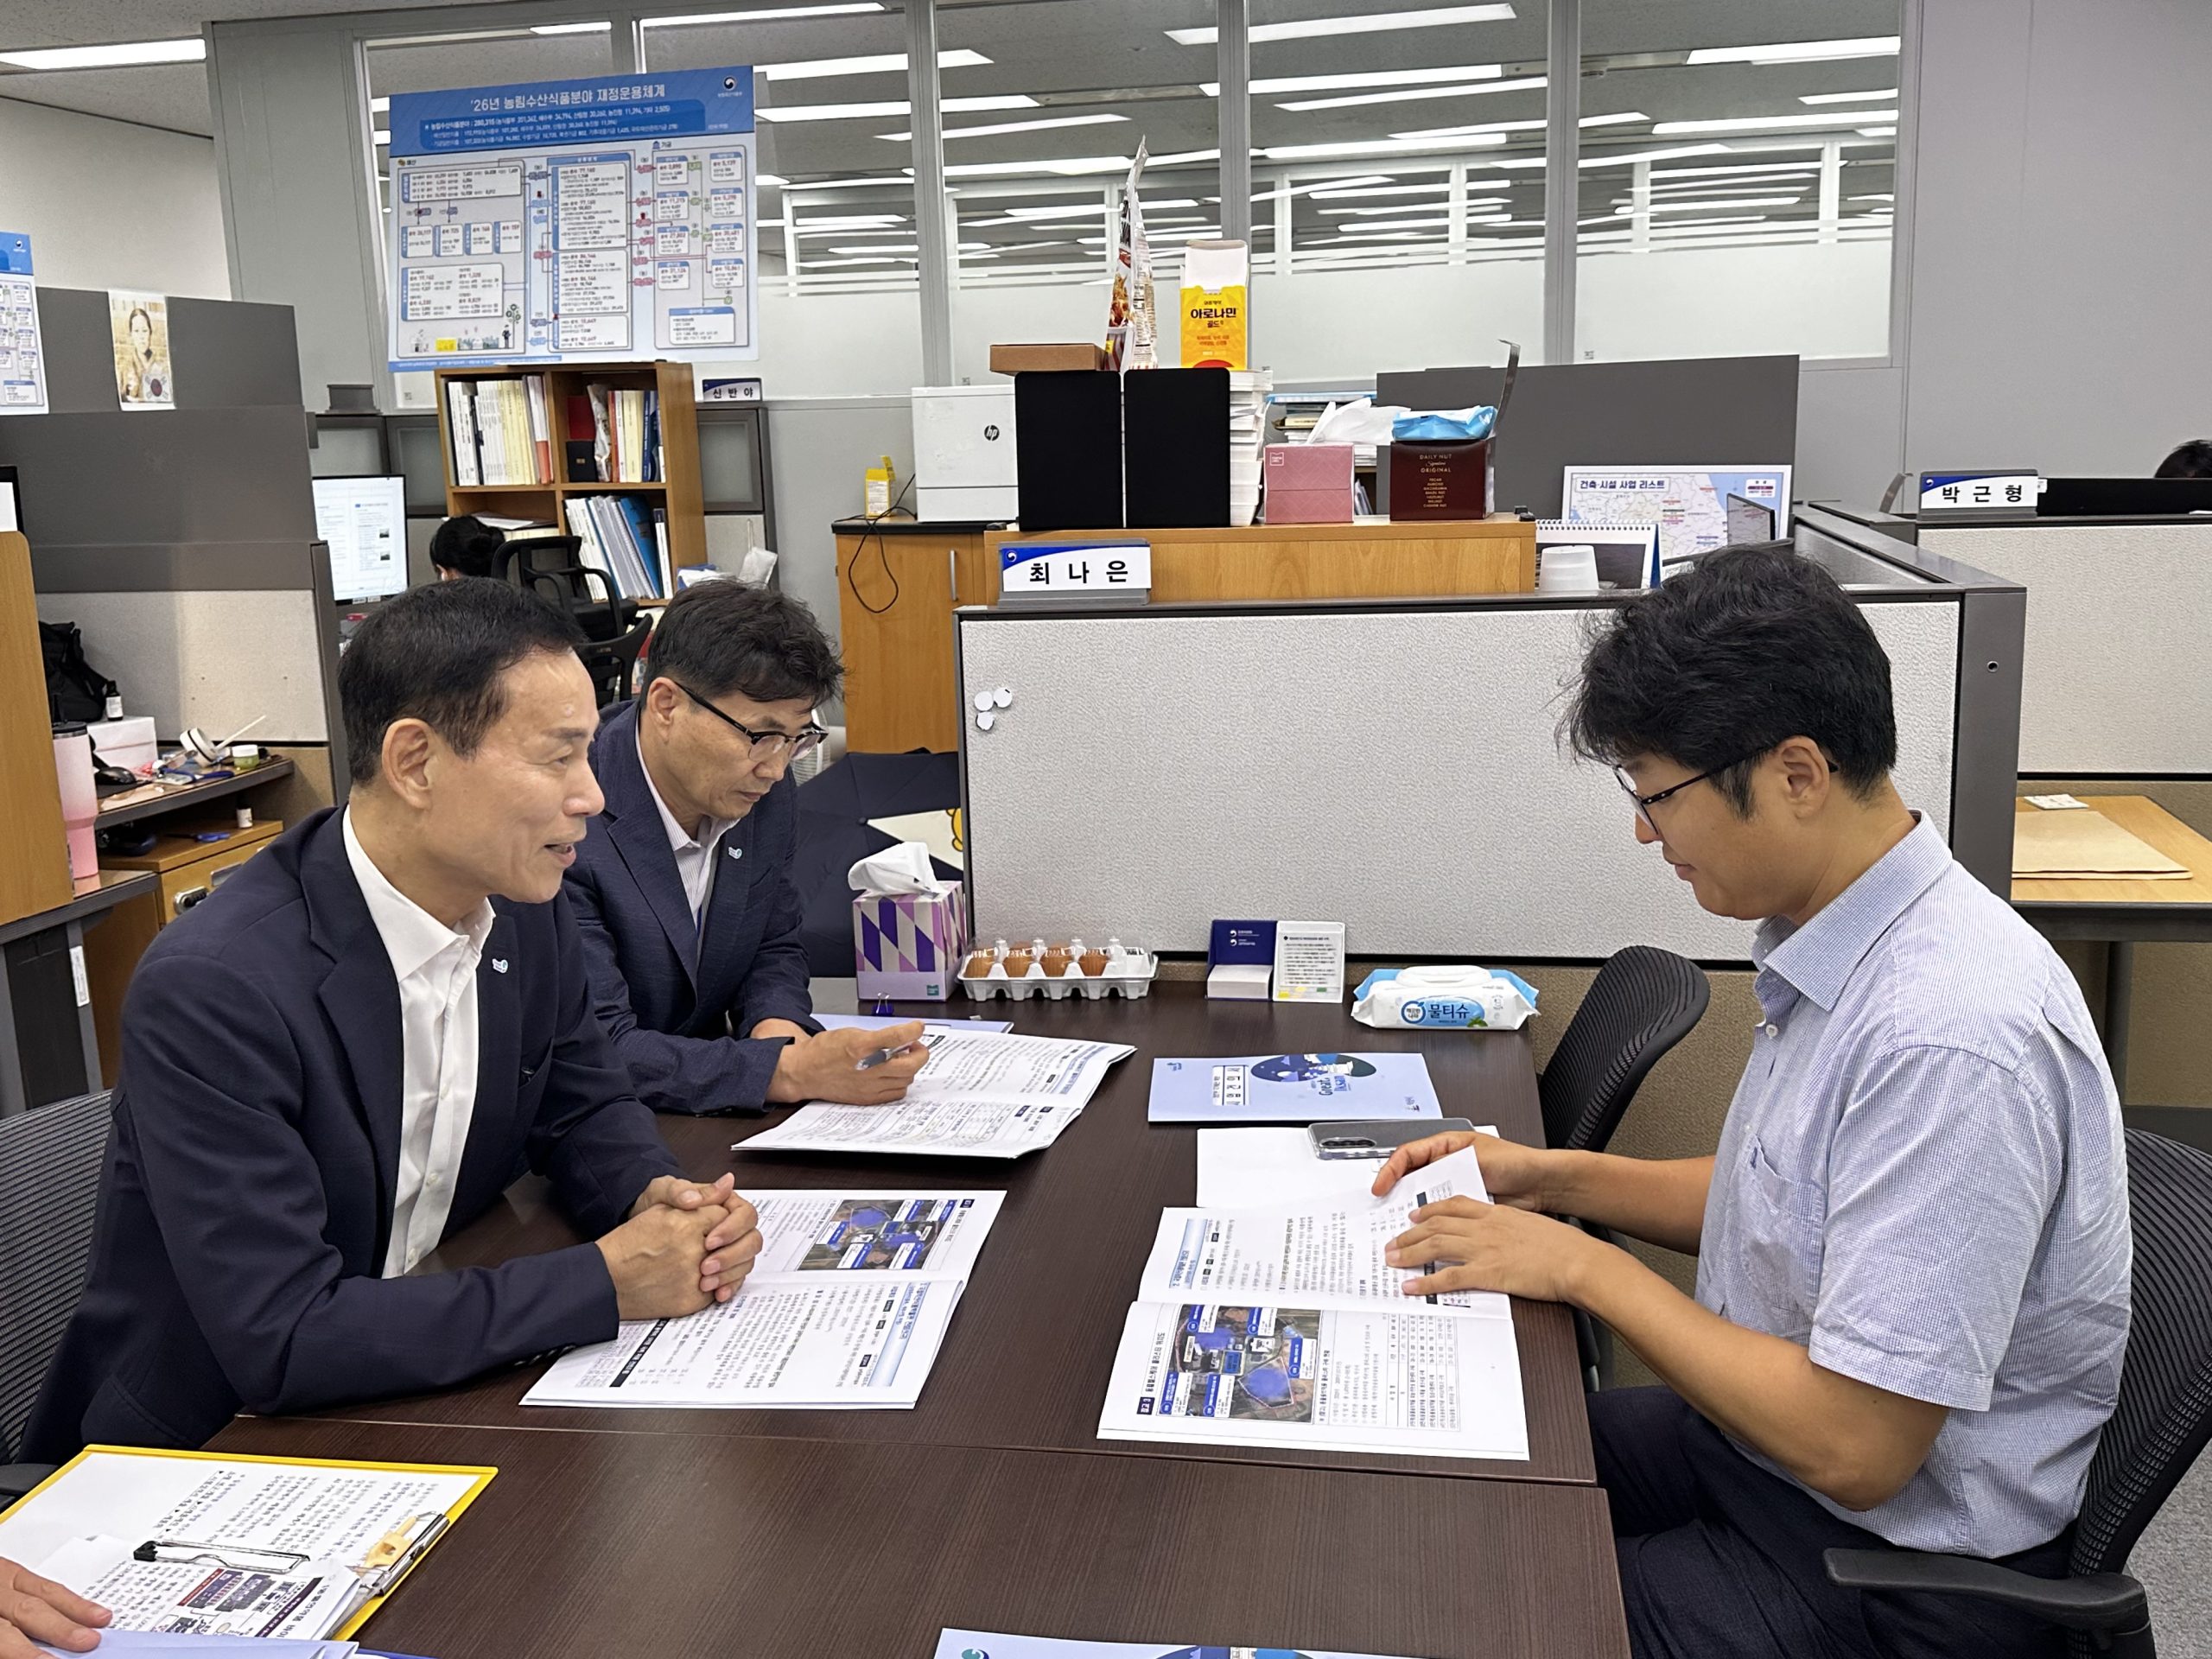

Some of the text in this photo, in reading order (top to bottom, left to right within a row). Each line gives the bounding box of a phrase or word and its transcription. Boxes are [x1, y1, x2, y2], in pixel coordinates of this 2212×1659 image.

[505, 90, 593, 110] 농림수산식품분야
[597, 84, 665, 102] 재정운용체계
[1191, 308, 1236, 319] 아로나민
[713, 387, 753, 398] 신 반 야
[985, 424, 1000, 441] hp
[1619, 480, 1637, 490] 사업
[1639, 480, 1666, 490] 리스트
[1942, 485, 2022, 503] 박 근 형
[1030, 560, 1128, 584] 최 나 은
[1427, 1004, 1471, 1019] 물티슈
